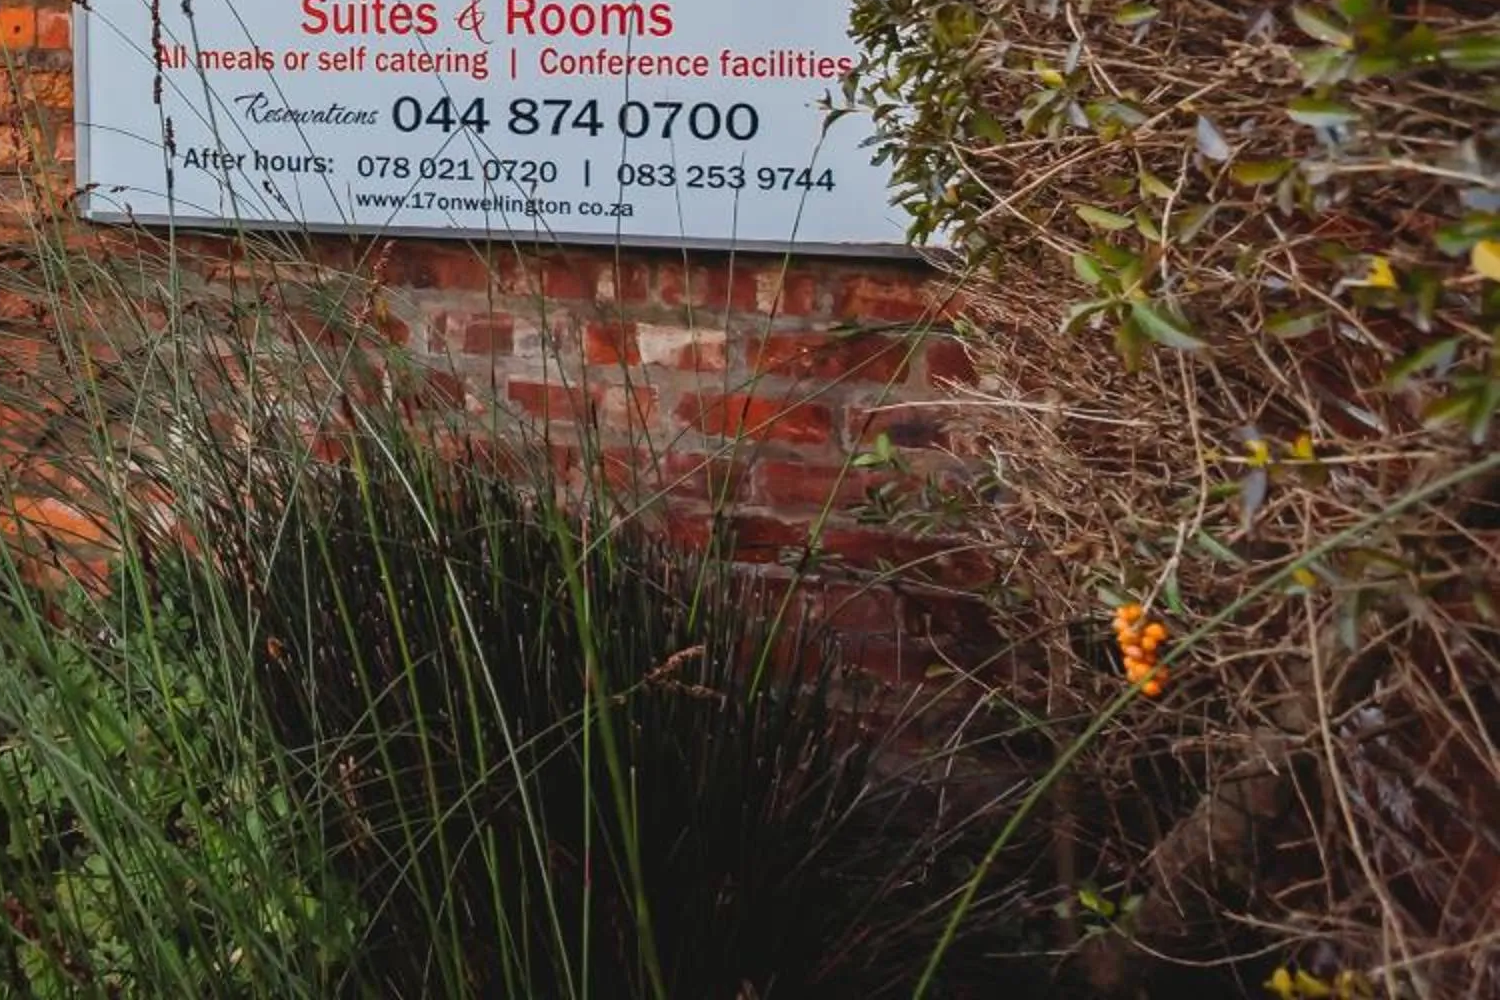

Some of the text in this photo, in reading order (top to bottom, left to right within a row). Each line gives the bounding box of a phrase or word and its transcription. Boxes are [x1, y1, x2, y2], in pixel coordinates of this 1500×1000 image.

[157, 44, 186, 69] All
[197, 44, 275, 70] meals
[284, 51, 309, 71] or
[318, 47, 370, 72] self
[375, 48, 489, 81] catering
[540, 47, 709, 76] Conference
[720, 49, 852, 79] facilities
[234, 91, 759, 141] Reservations 044 874 0700
[184, 148, 246, 170] After
[255, 149, 334, 175] hours:
[358, 155, 411, 179] 078
[420, 156, 474, 181] 021
[484, 158, 557, 184] 0720
[617, 162, 676, 188] 083
[687, 165, 747, 190] 253
[757, 167, 837, 192] 9744
